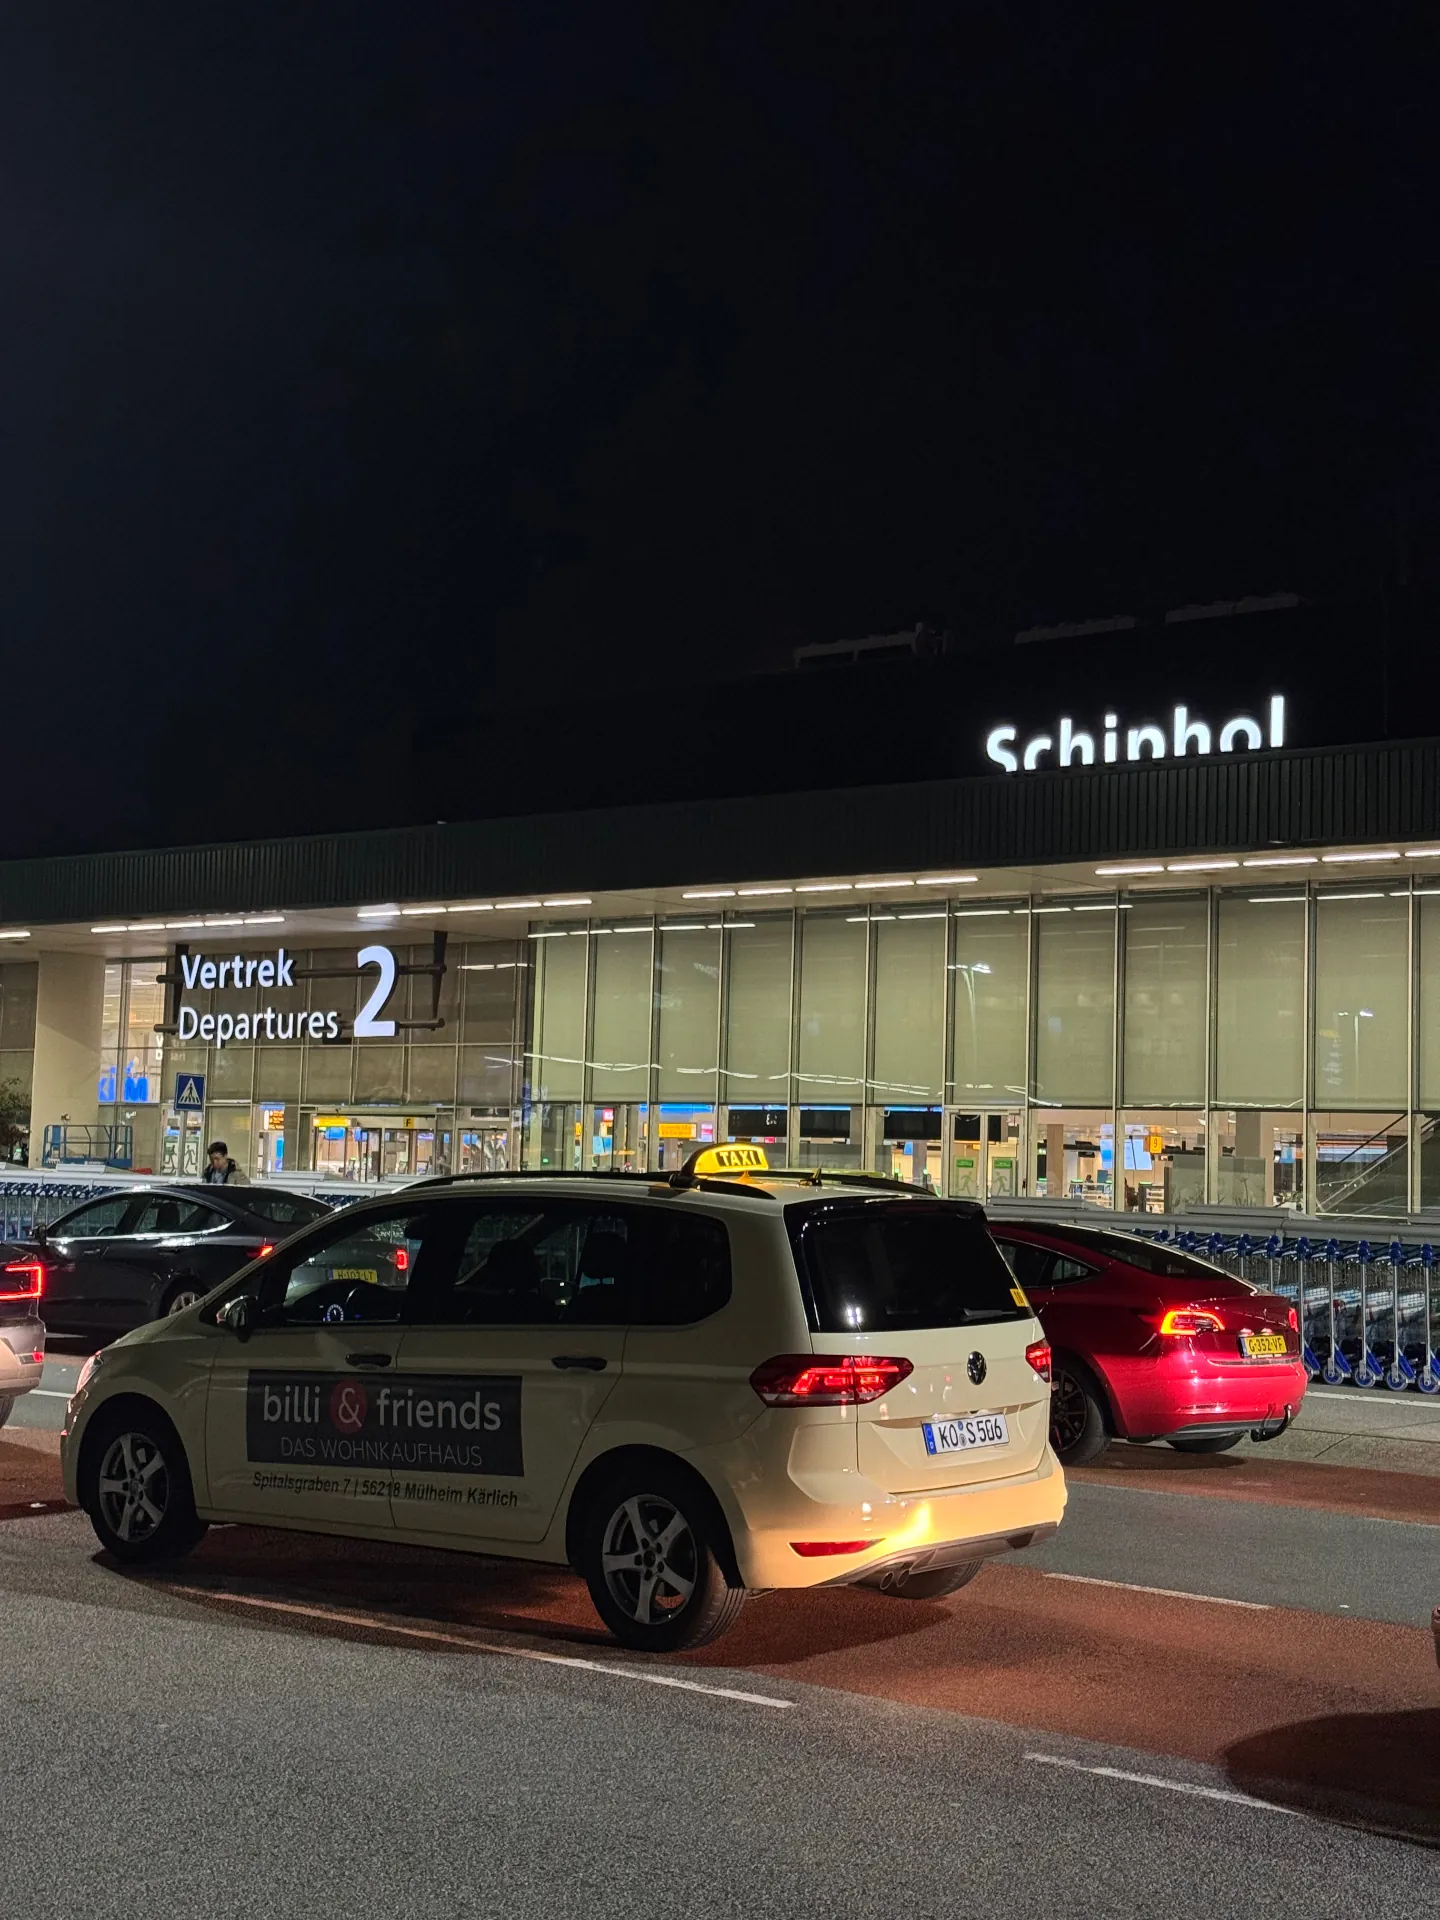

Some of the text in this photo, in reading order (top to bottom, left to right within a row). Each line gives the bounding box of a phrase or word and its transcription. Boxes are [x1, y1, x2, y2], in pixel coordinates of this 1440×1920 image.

[181, 949, 294, 990] Vertrek
[354, 945, 396, 1037] 2
[179, 1006, 338, 1049] Departures
[719, 1150, 761, 1167] TAXI
[263, 1385, 501, 1431] billi & friends
[280, 1437, 483, 1467] DAS WOHNKAUFHAUS
[938, 1424, 959, 1449] KO
[253, 1472, 340, 1494] Spitalsgraben
[343, 1479, 351, 1494] 7
[361, 1480, 401, 1498] 56218
[404, 1482, 463, 1504] Mülheim
[467, 1487, 519, 1508] Kärlich
